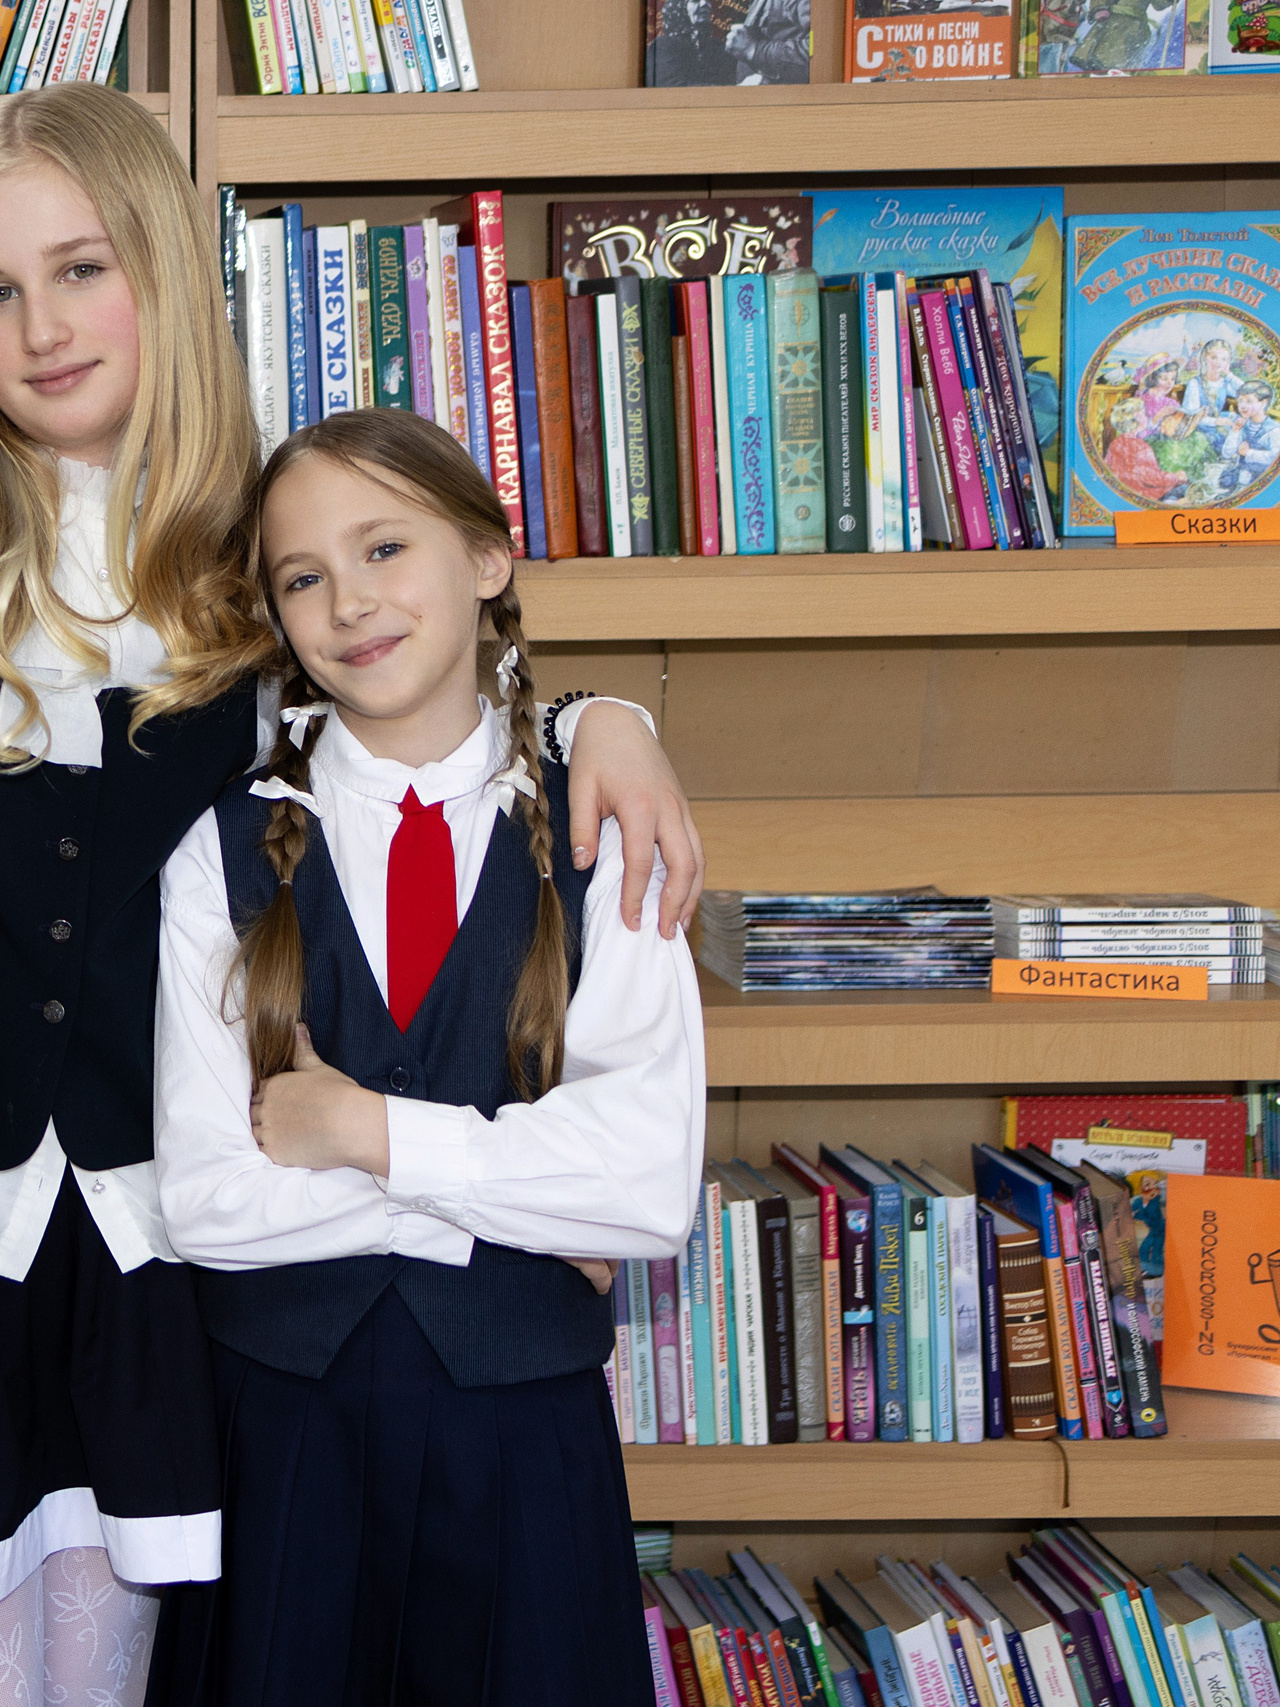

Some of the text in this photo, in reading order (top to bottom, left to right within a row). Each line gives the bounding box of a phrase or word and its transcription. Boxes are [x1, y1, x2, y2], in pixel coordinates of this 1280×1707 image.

[915, 39, 1004, 68] О ВОЙНЕ
[938, 25, 980, 42] ПЕСНИ
[871, 197, 987, 230] Волшебные
[1140, 228, 1250, 243] Лев Толстой
[858, 226, 999, 264] русские сказки
[375, 236, 404, 345] ЧУДО ЧУДНОЕ
[1079, 248, 1224, 305] ВСЕ ЛУЧШИЕ
[1124, 273, 1267, 309] И РАССКАЗЫ
[260, 244, 274, 369] ЯКУТСКИЕ СКАЗКИ
[320, 248, 350, 382] СКАЗКИ
[440, 254, 464, 398] СКАЗКИ ДОБРОЙ
[838, 312, 846, 340] ВЕКОВ
[968, 307, 983, 349] цветочек
[865, 282, 879, 431] МИР СКАЗОК АНДЕРСЕНА
[931, 304, 953, 375] Холли Вебб
[480, 241, 521, 505] КАРНАВАЛ СКАЗОК
[745, 322, 756, 414] ЧЕРНАЯ КУРИЦА
[976, 349, 992, 394] Аленький
[471, 379, 485, 426] ДОБРЫЕ
[622, 337, 646, 489] СЕВЕРНЫЕ СКАЗКИ
[839, 383, 848, 433] ПИСАТЕЛЕЙ
[903, 396, 914, 434] АЙБОЛИТ
[915, 325, 926, 345] Даль
[932, 415, 944, 443] Сказки
[938, 451, 953, 494] пословицы
[957, 330, 991, 467] Андерсен Сказки
[842, 470, 850, 507] РУССКИЕ
[995, 452, 1009, 489] Городок
[1170, 513, 1257, 534] Сказки
[1020, 965, 1180, 992] Фантастика
[824, 1214, 838, 1254] Марсель
[914, 1210, 925, 1226] 6
[1047, 1214, 1058, 1253] Марсель
[710, 1184, 727, 1362] ПРИКЛЮЧЕНИЯ ВАСИ КУРОЛЕСОВА
[770, 1231, 784, 1277] Карлсоне
[879, 1223, 901, 1315] Айви Покет!
[935, 1220, 946, 1316] СОСЕДСКИЙ ПАРЕНЬ
[1198, 1210, 1218, 1356] BOOKCROSSING
[774, 1291, 785, 1331] Малыше
[1087, 1259, 1118, 1378] ЛУЧШИЕ ПОДРУГИ
[828, 1270, 840, 1412] СКАЗКИ КОТА МУРЛЫКИ
[1051, 1268, 1077, 1410] СКАЗКИ КОТА МУРЛЫКИ
[1125, 1309, 1150, 1401] ФИЛОСОФСКИЙ КАМЕНЬ
[779, 1346, 788, 1383] повести
[779, 1388, 792, 1406] Три
